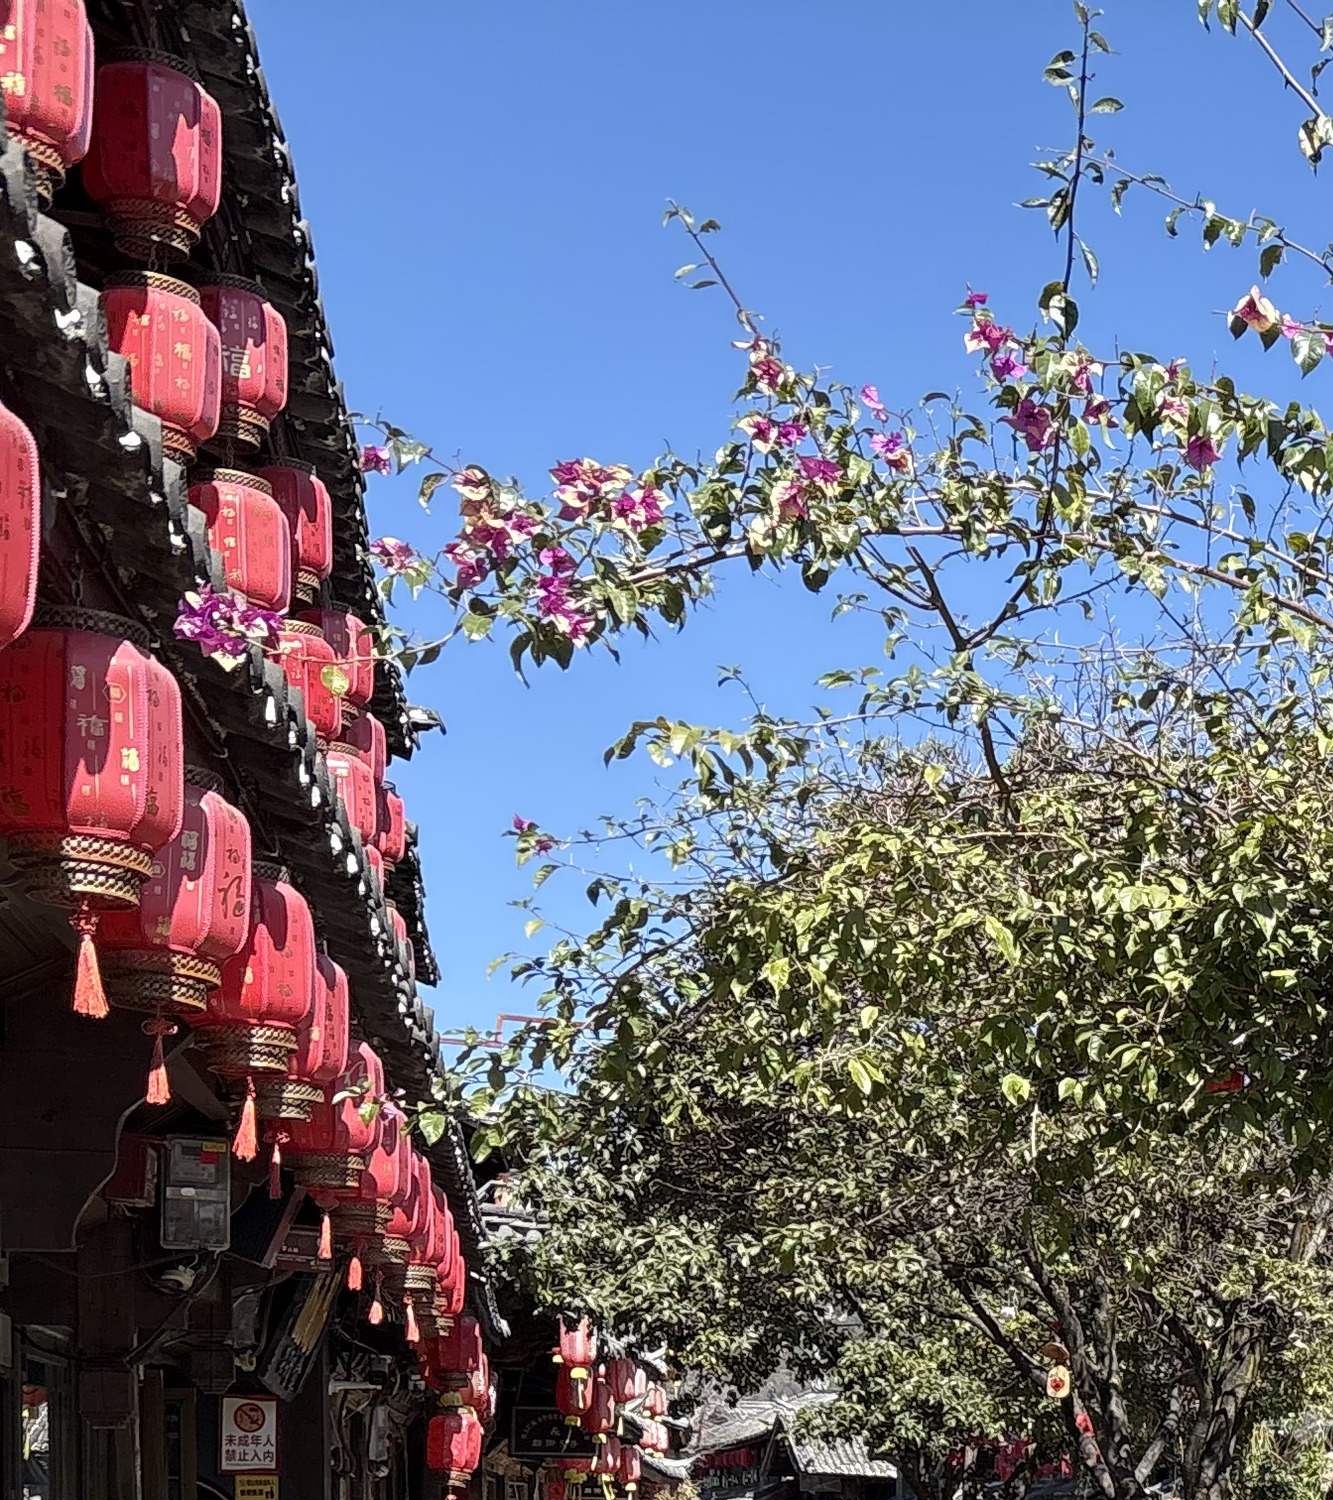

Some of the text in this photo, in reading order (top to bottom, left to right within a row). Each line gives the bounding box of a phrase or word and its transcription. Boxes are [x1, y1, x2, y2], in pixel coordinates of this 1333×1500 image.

[224, 1434, 274, 1447] 未成年人
[225, 1449, 274, 1462] 禁止入内
